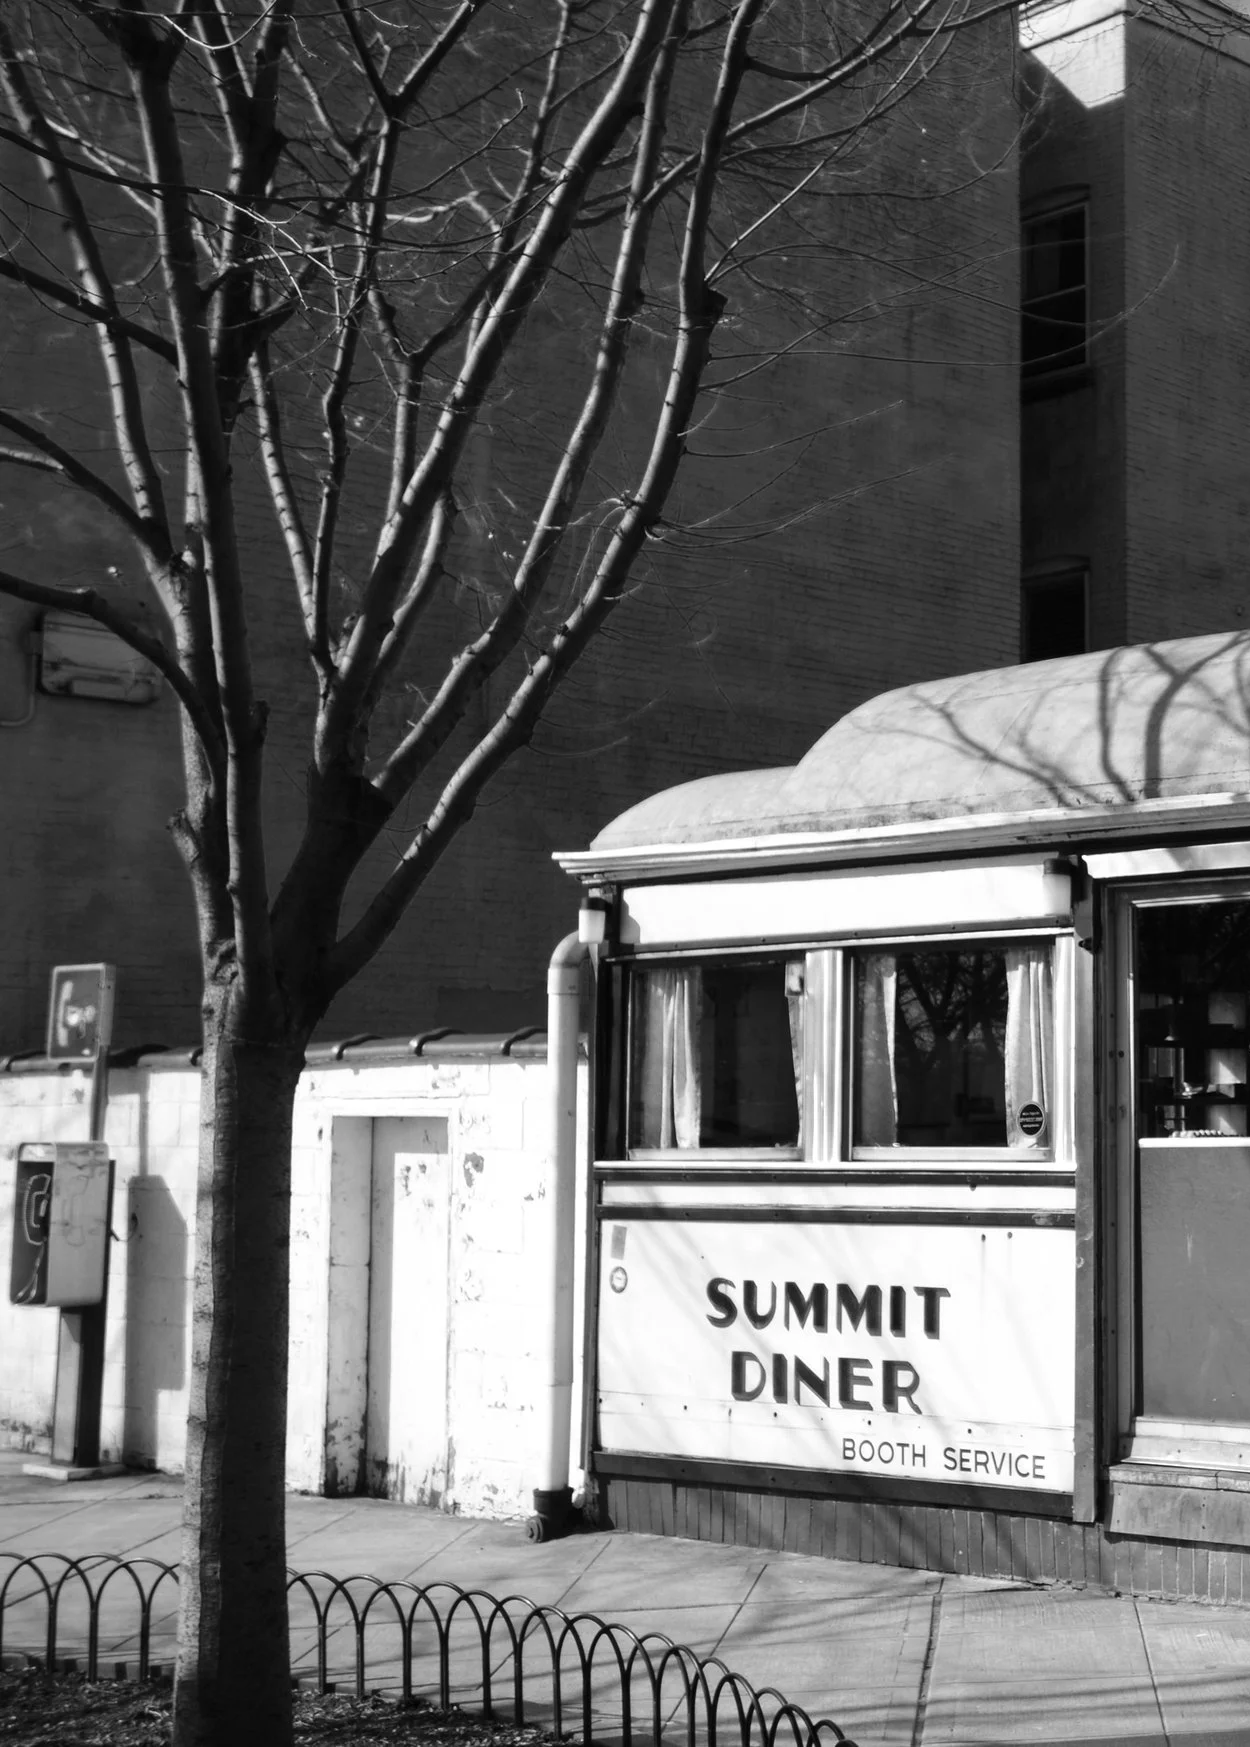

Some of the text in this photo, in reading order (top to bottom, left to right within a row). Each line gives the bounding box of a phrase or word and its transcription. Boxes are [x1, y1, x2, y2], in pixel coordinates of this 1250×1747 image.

[705, 1277, 951, 1340] SUMMIT
[731, 1351, 923, 1415] DINER
[842, 1438, 1046, 1479] BOOTH SERVICE
